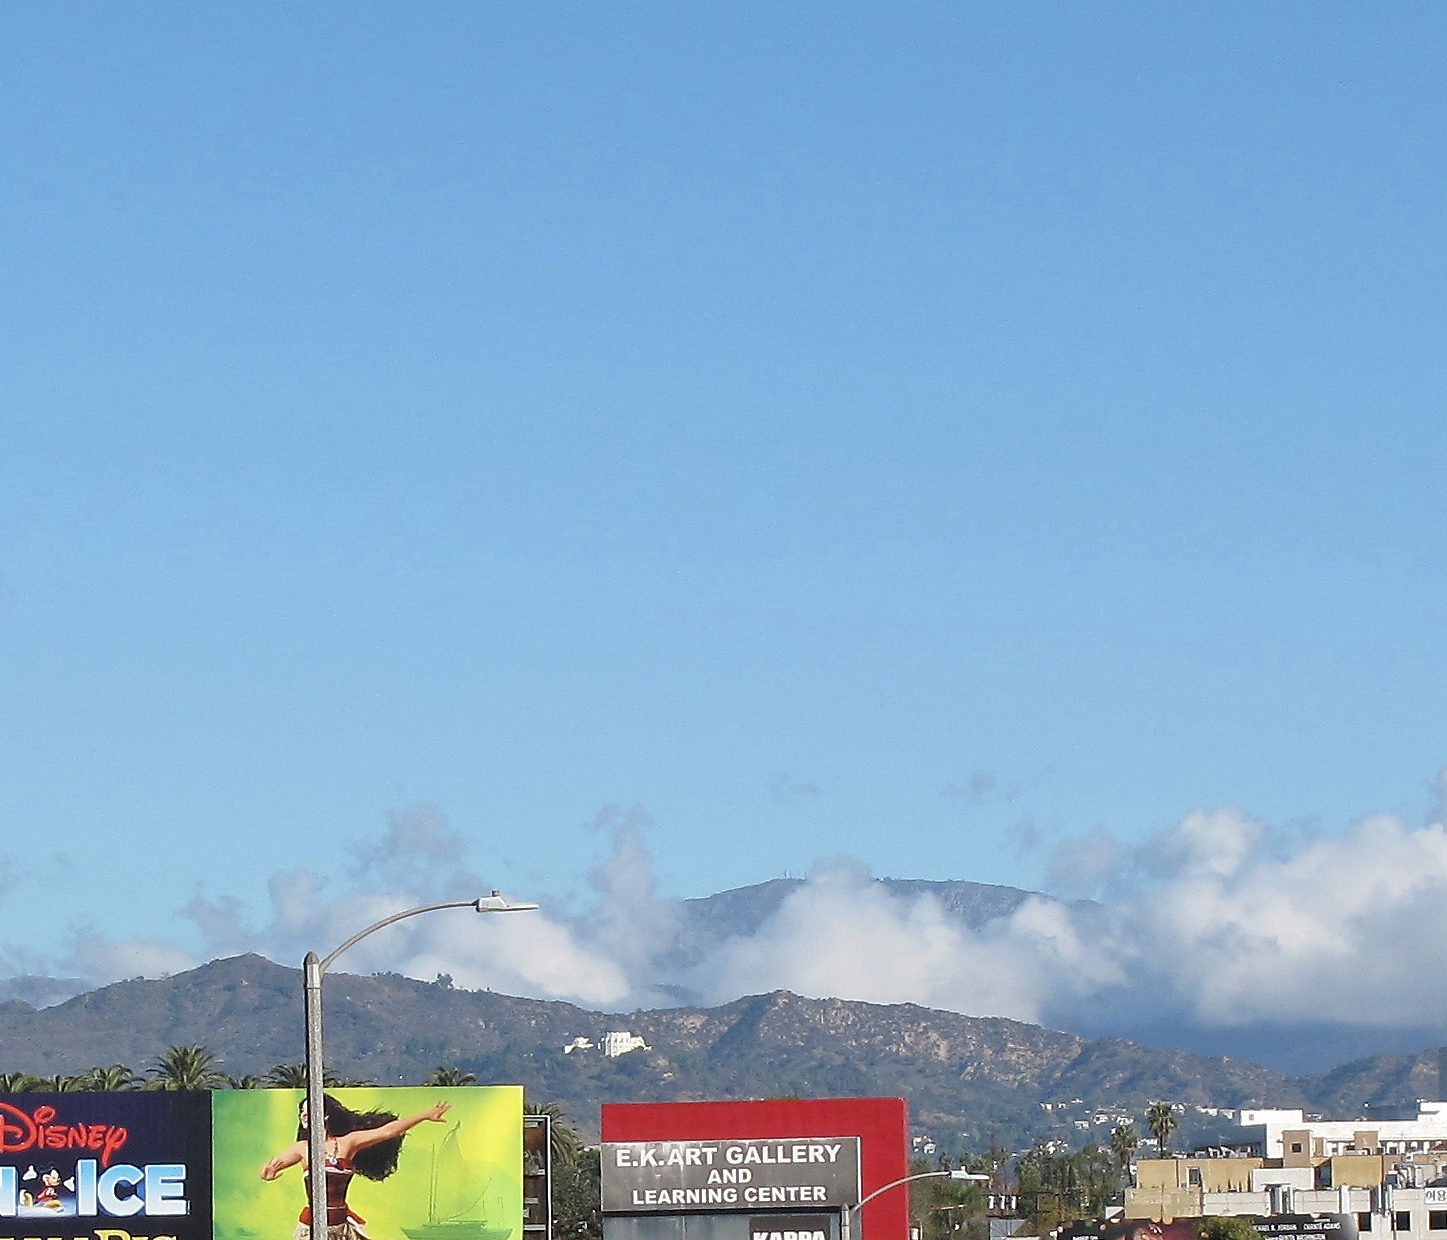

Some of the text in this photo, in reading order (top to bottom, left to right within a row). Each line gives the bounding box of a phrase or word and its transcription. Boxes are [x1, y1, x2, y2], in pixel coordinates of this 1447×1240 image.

[725, 1144, 842, 1164] GALLERY
[707, 1169, 752, 1184] AND
[75, 1157, 190, 1219] ICE
[633, 1187, 827, 1205] LEARNING CENTER
